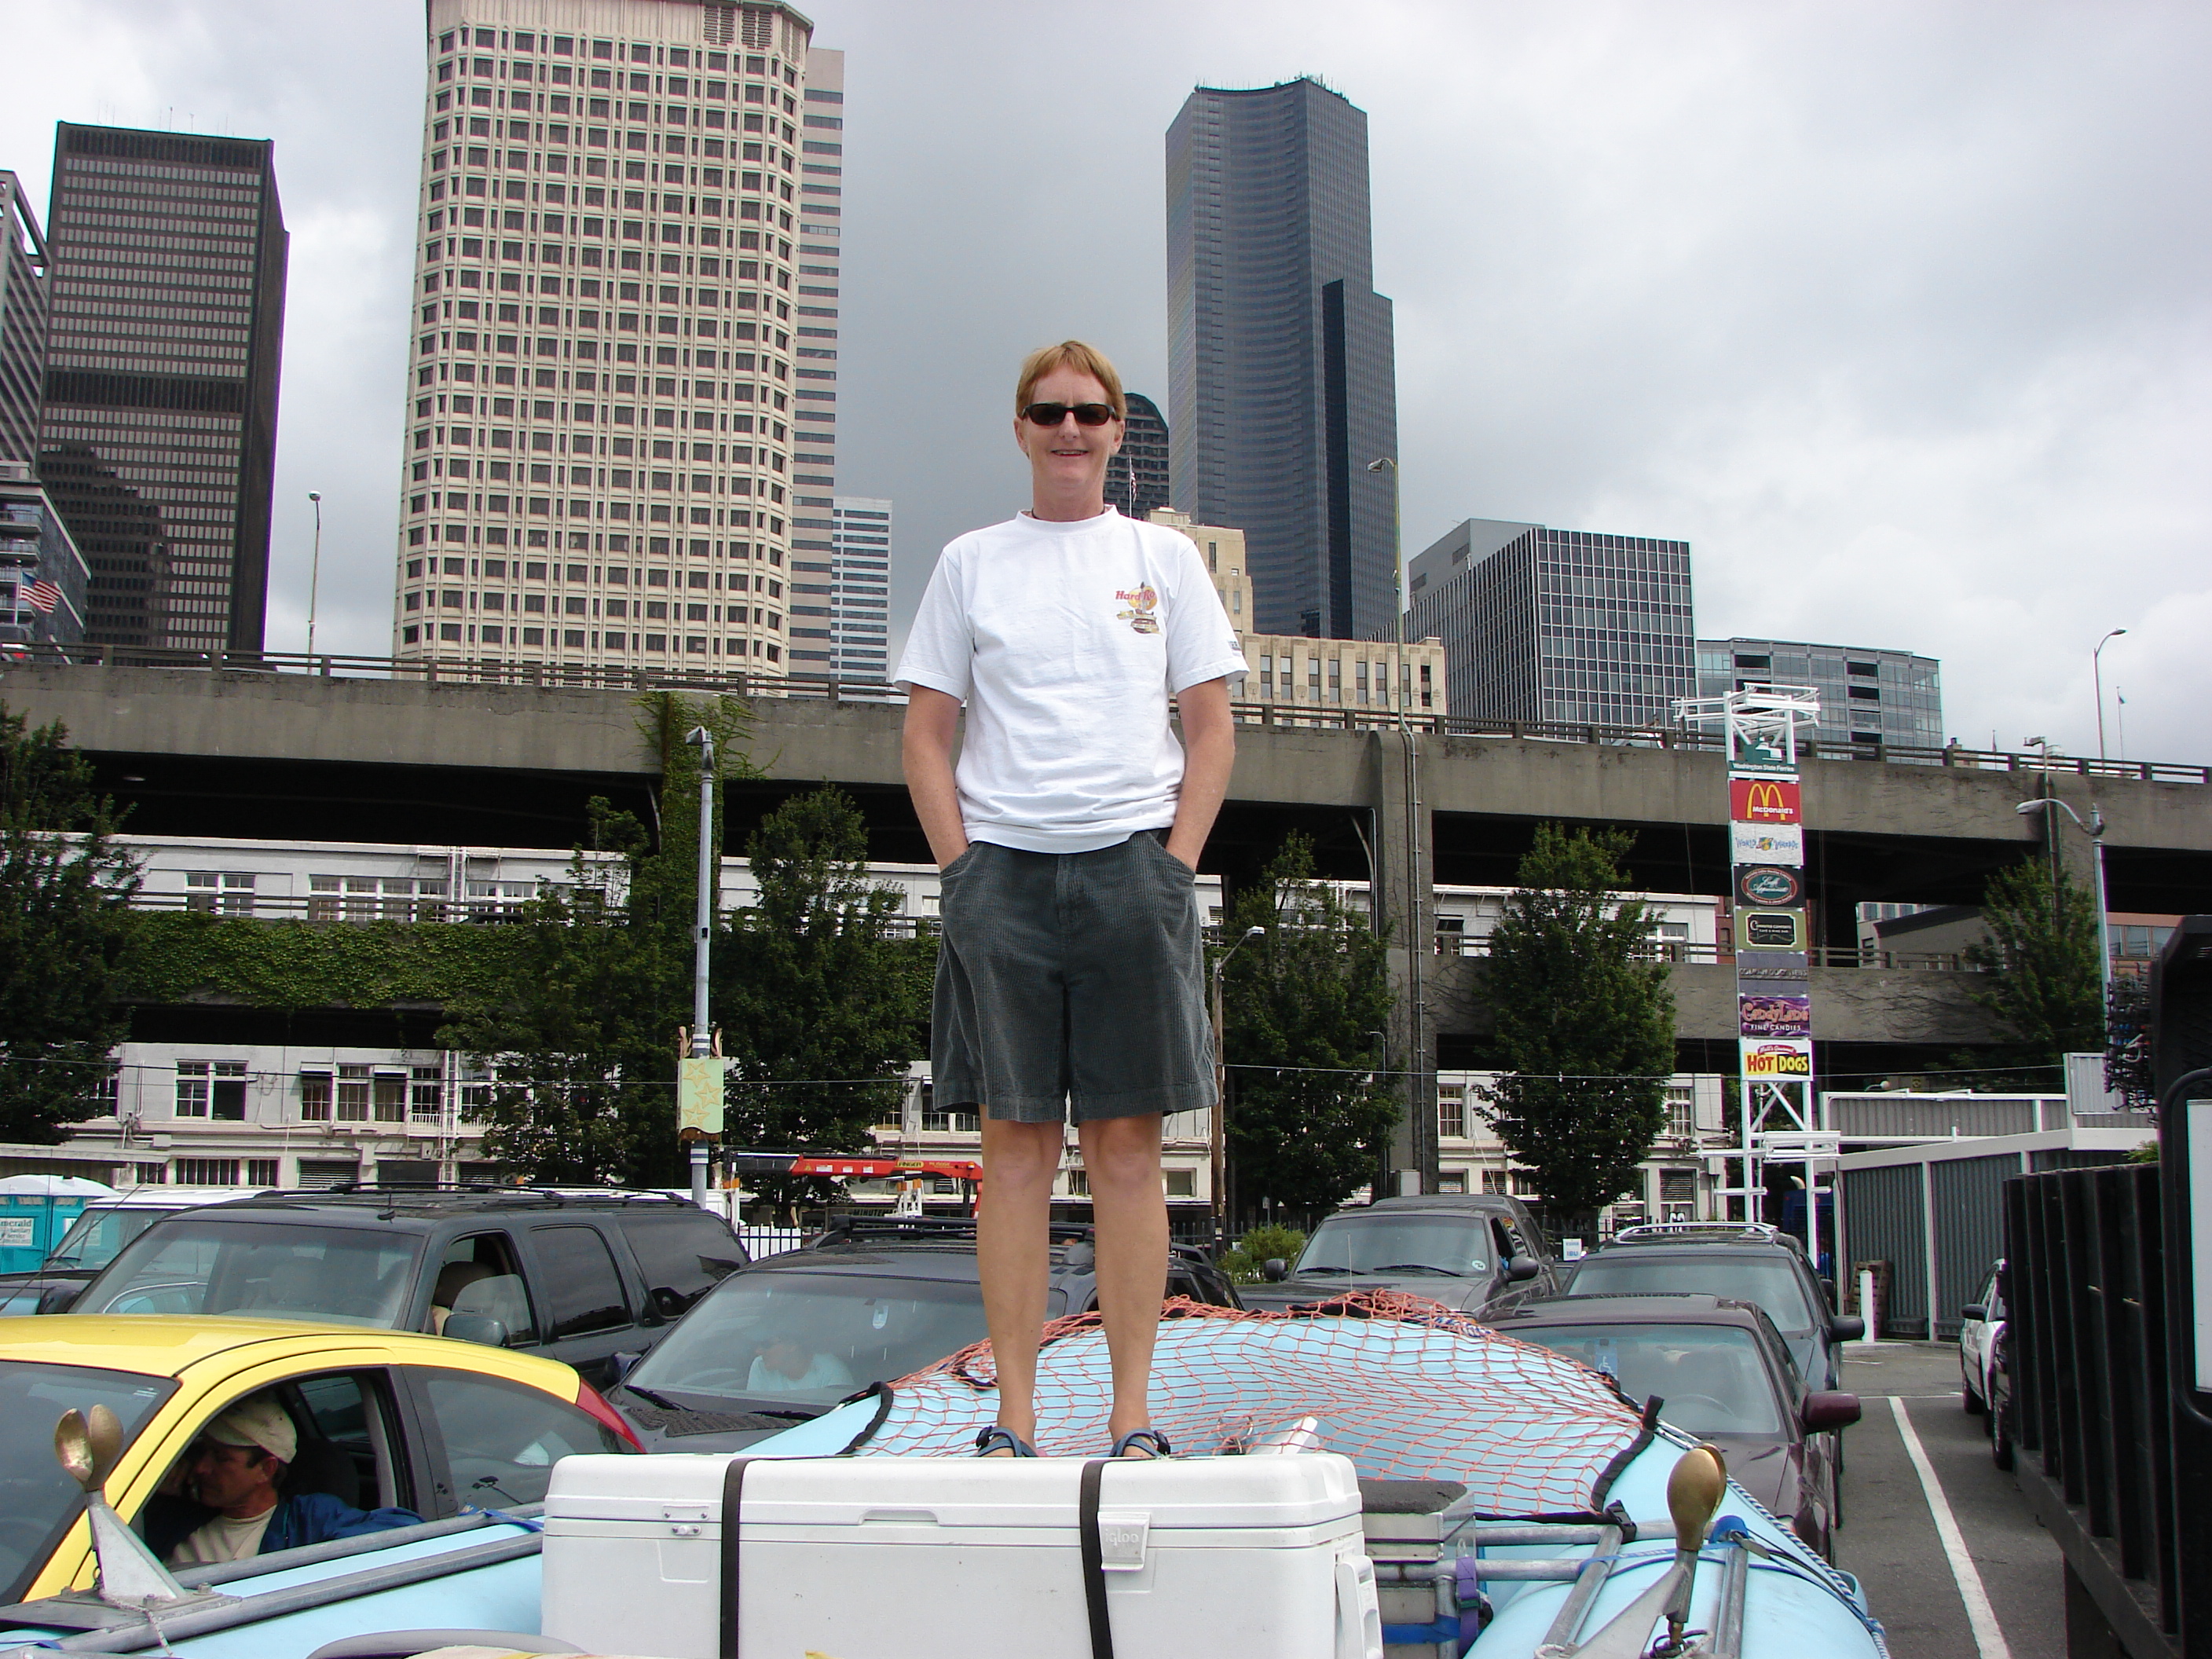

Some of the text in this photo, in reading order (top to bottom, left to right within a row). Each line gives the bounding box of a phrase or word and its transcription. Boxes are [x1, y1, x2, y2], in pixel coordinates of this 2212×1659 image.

[1115, 589, 1156, 601] Hard Ro
[1752, 806, 1794, 815] McDonald's
[1746, 1055, 1808, 1072] HOT DOGS
[1105, 1527, 1139, 1546] igloo
